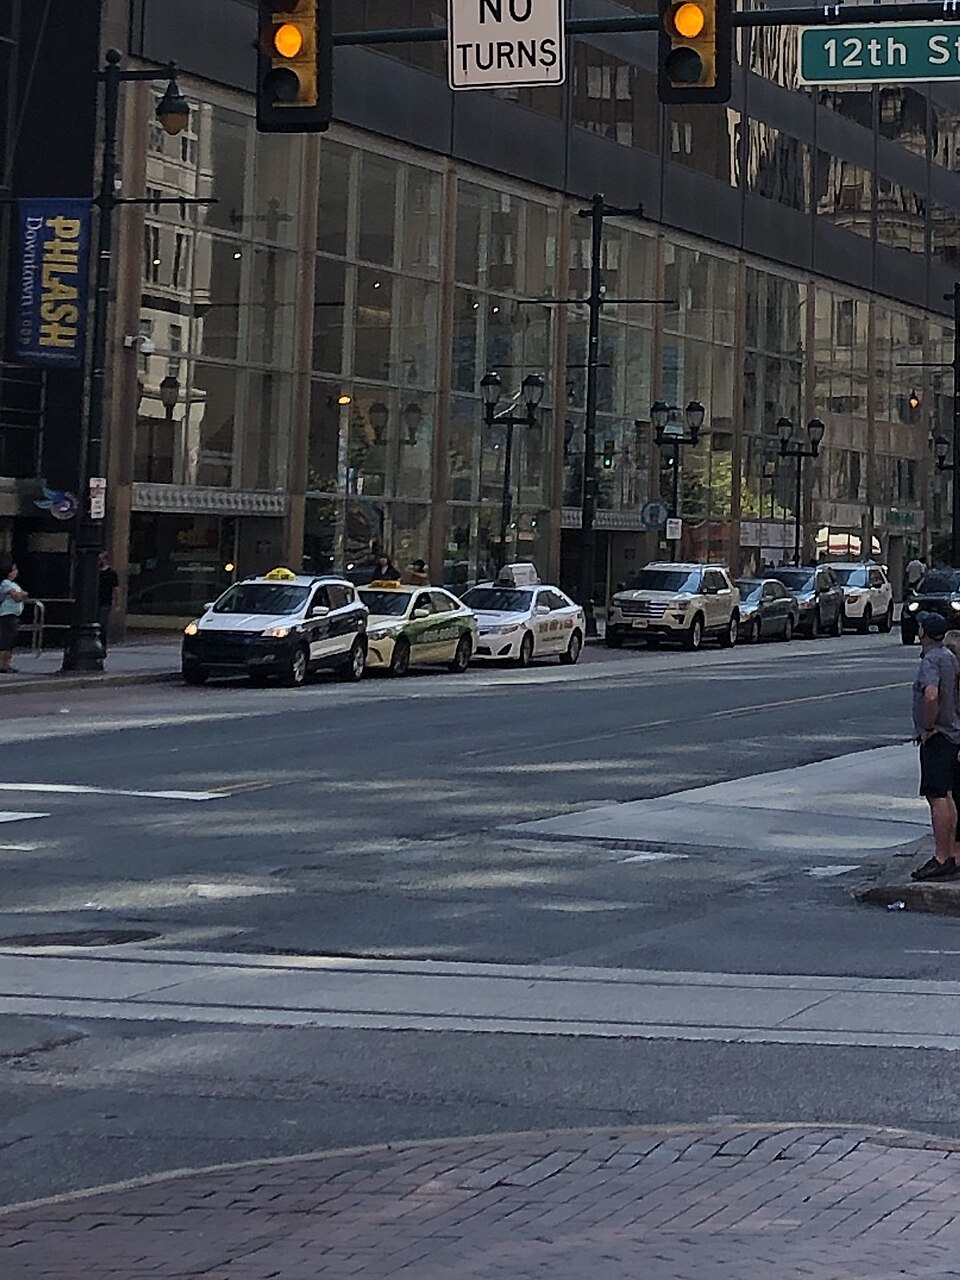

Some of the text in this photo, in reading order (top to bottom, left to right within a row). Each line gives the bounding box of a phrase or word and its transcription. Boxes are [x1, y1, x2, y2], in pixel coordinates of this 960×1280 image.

[456, 38, 557, 70] TURNS
[824, 37, 907, 67] 12th
[21, 216, 43, 308] Downtown
[38, 216, 81, 348] PHLASH
